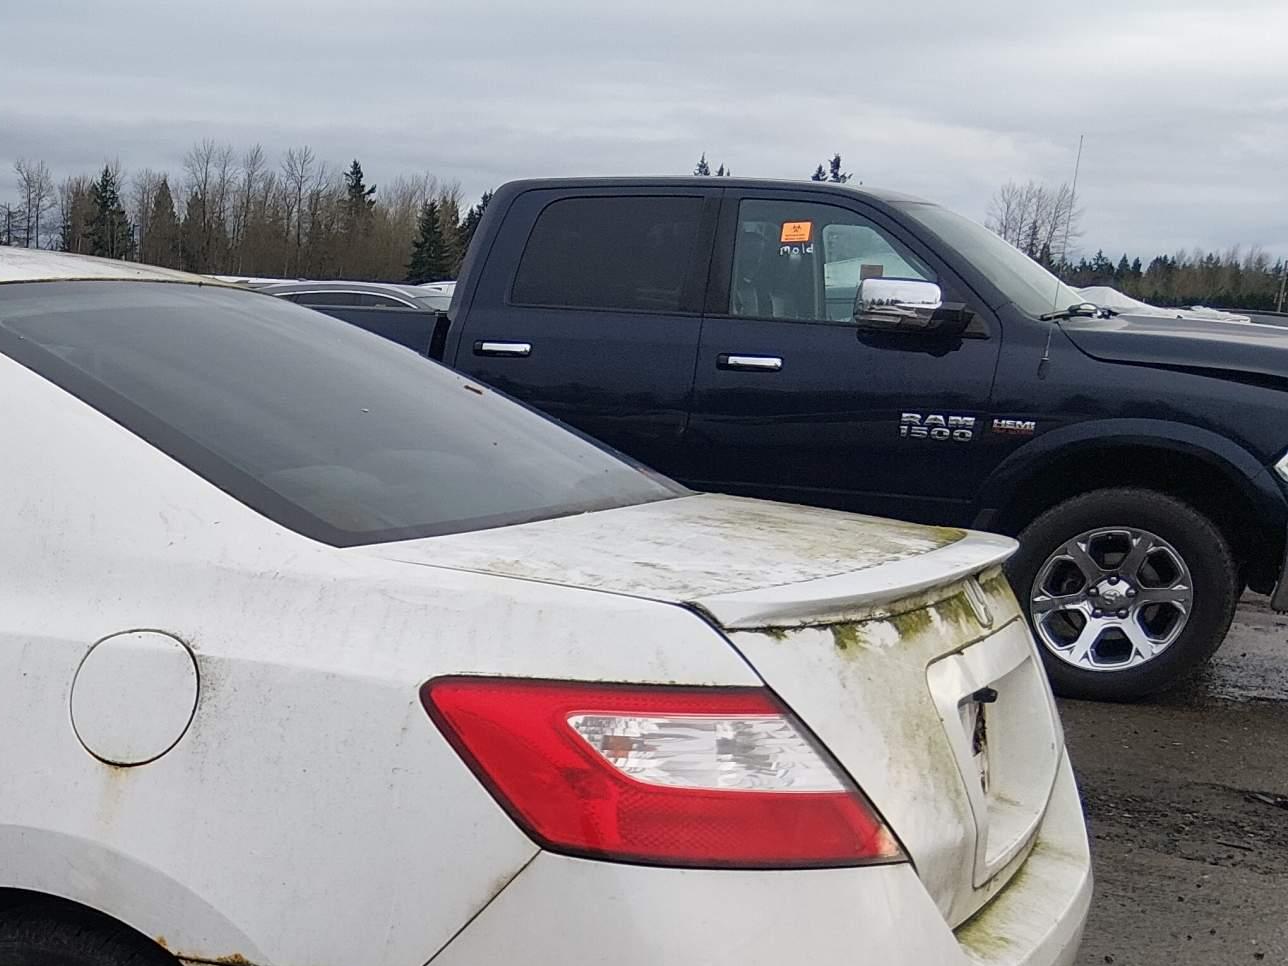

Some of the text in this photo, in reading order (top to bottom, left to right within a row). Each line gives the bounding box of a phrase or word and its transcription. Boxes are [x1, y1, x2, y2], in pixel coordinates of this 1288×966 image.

[900, 413, 976, 428] RAM
[992, 418, 1036, 431] HEMI
[899, 425, 973, 442] 1500
